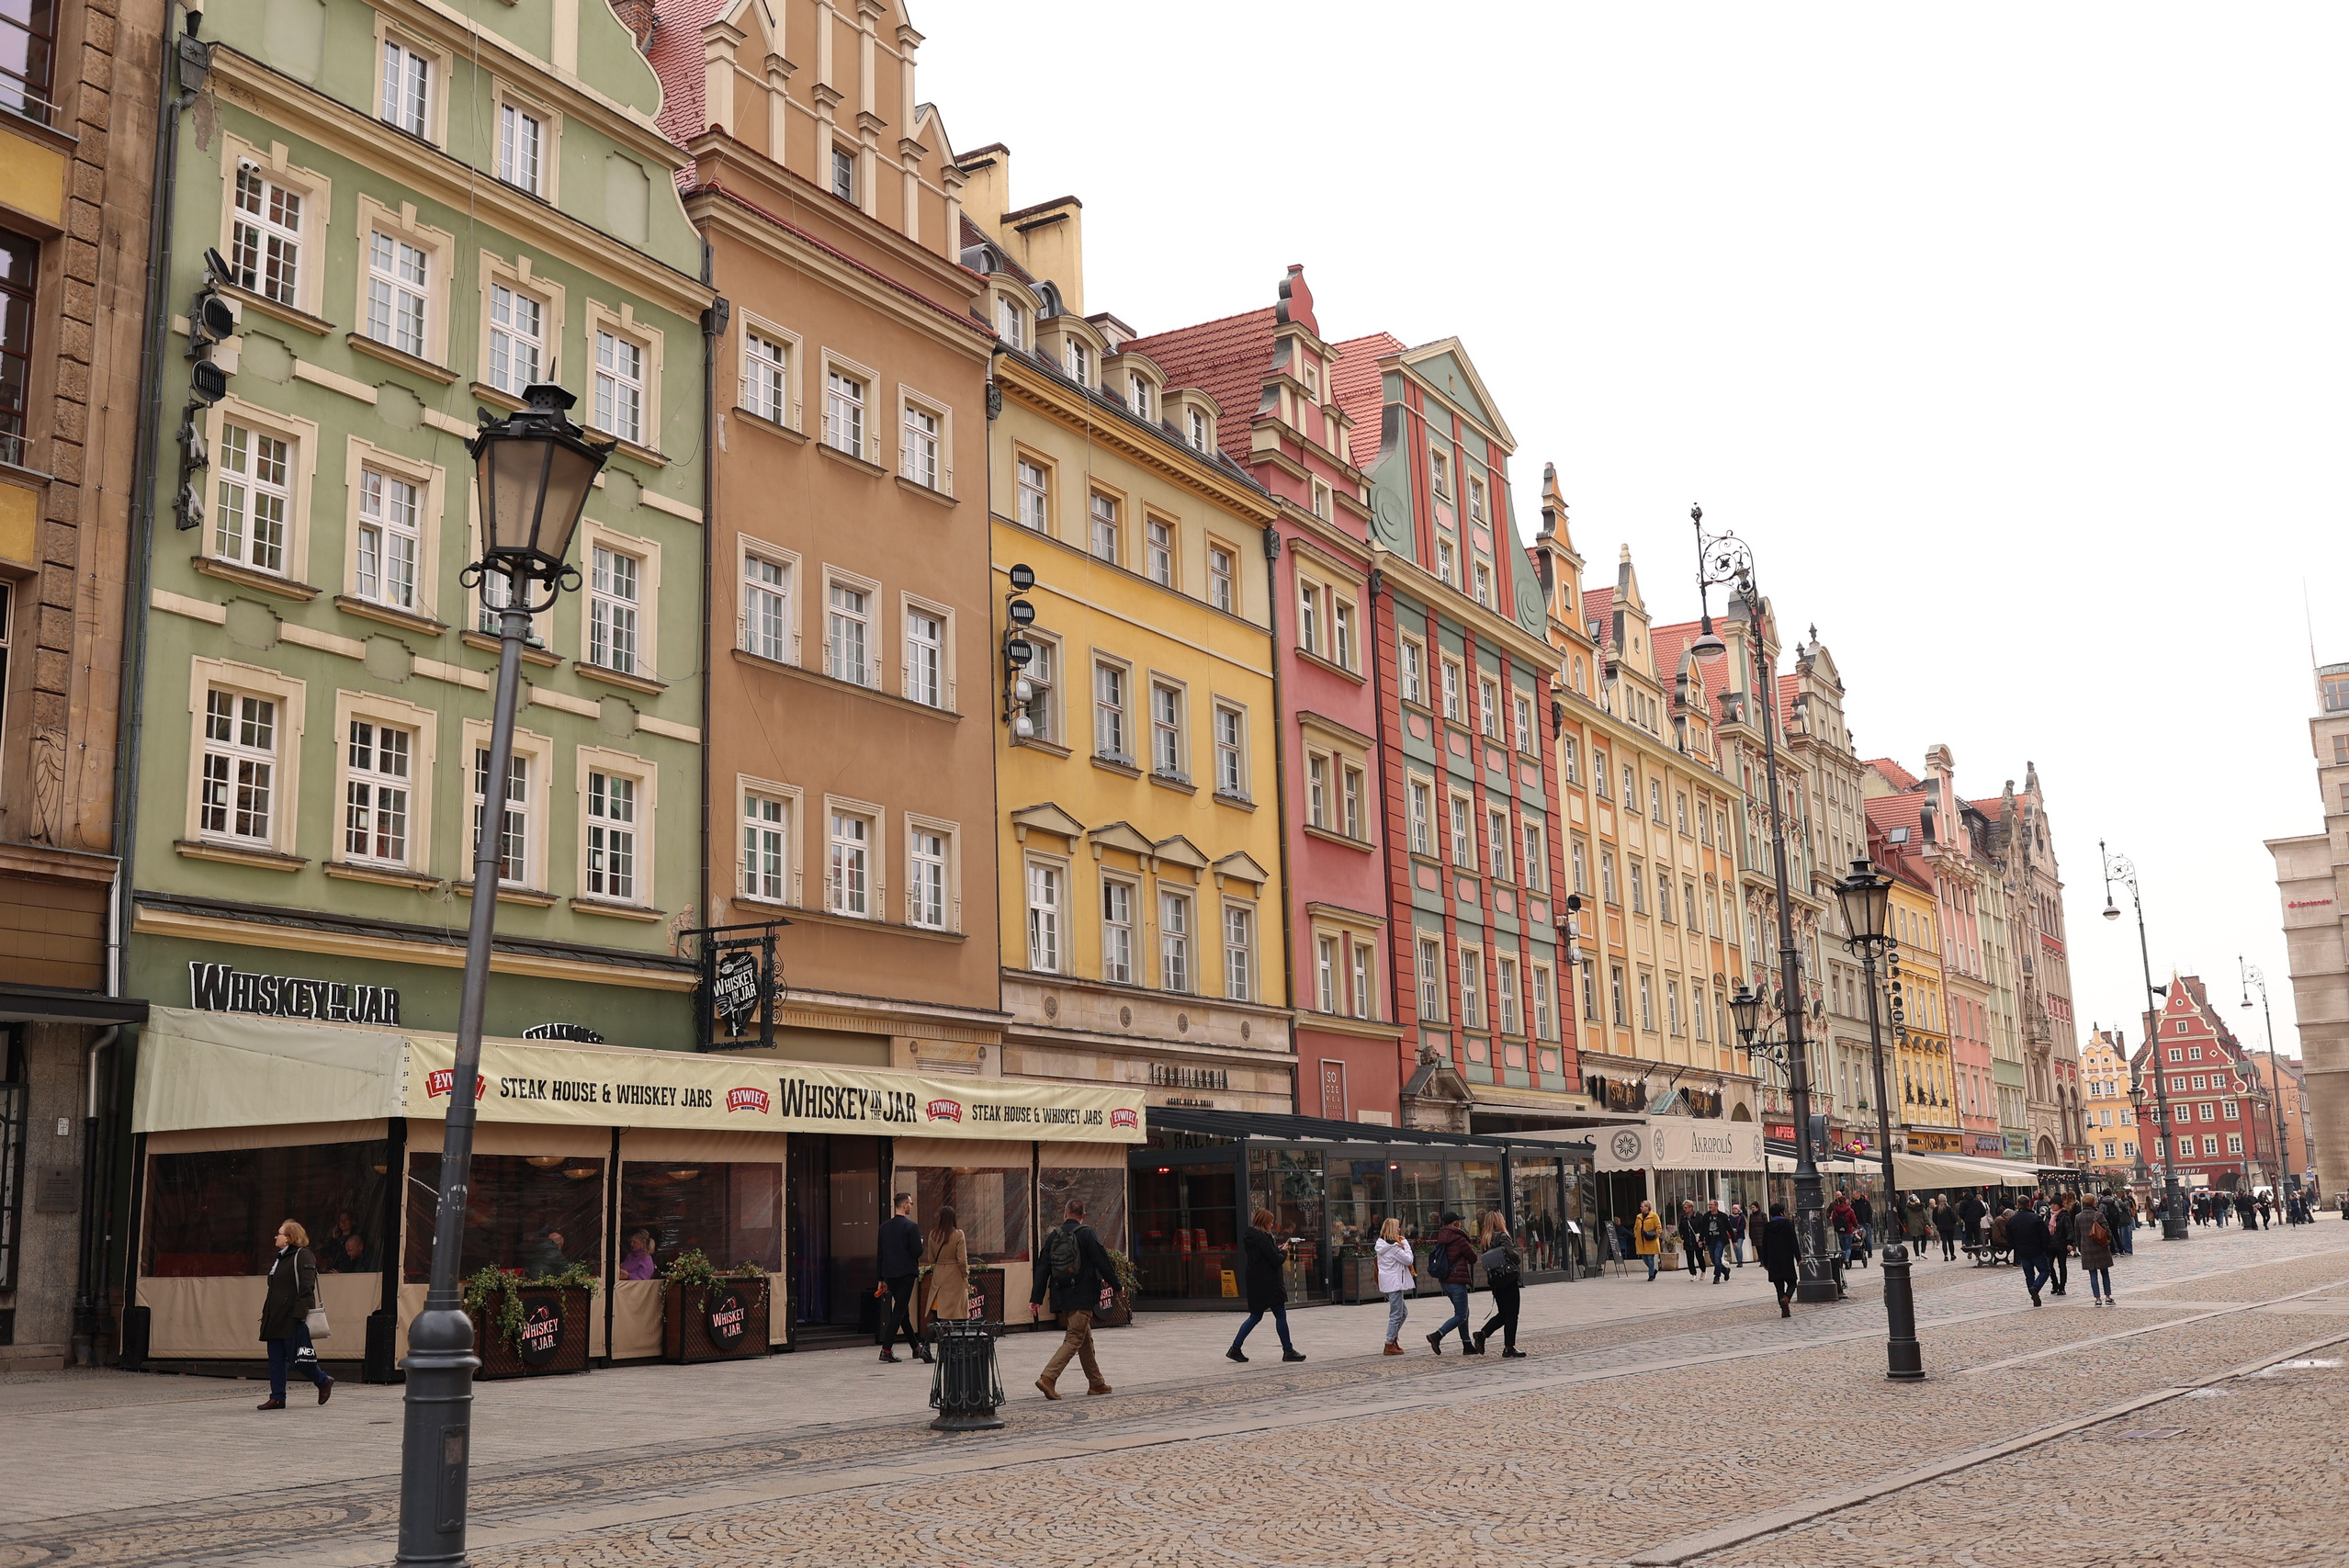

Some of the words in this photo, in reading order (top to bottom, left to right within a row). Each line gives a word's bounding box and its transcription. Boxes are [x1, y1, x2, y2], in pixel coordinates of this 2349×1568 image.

[2298, 899, 2332, 908] Santander
[713, 969, 753, 997] WHISKEY
[189, 961, 328, 1020] WHISKEY
[346, 985, 401, 1027] JAR
[731, 989, 740, 999] IN
[740, 983, 757, 1001] JAR
[1327, 1071, 1337, 1083] SO
[500, 1077, 548, 1100] STEAK
[552, 1080, 598, 1103] HOUSE
[602, 1083, 612, 1103] &
[616, 1084, 677, 1107] WHISKEY
[681, 1089, 713, 1109] JARS
[731, 1089, 765, 1106] ŻYWIEC
[1326, 1085, 1339, 1094] CZE
[779, 1077, 869, 1121] WHISKEY
[870, 1090, 882, 1110] IN
[883, 1090, 918, 1123] JAR
[931, 1100, 959, 1115] ŻYWIEC
[870, 1110, 881, 1121] THE
[972, 1104, 1001, 1122] STEAK
[1004, 1106, 1032, 1123] HOUSE
[1033, 1107, 1040, 1123] &
[1043, 1108, 1080, 1124] WHISKEY
[1083, 1110, 1103, 1125] JARS
[1113, 1110, 1136, 1124] ŻYWIEC
[1775, 1126, 1796, 1138] APTEK
[712, 1307, 744, 1327] WHISKEY
[521, 1317, 559, 1340] WHISKEY
